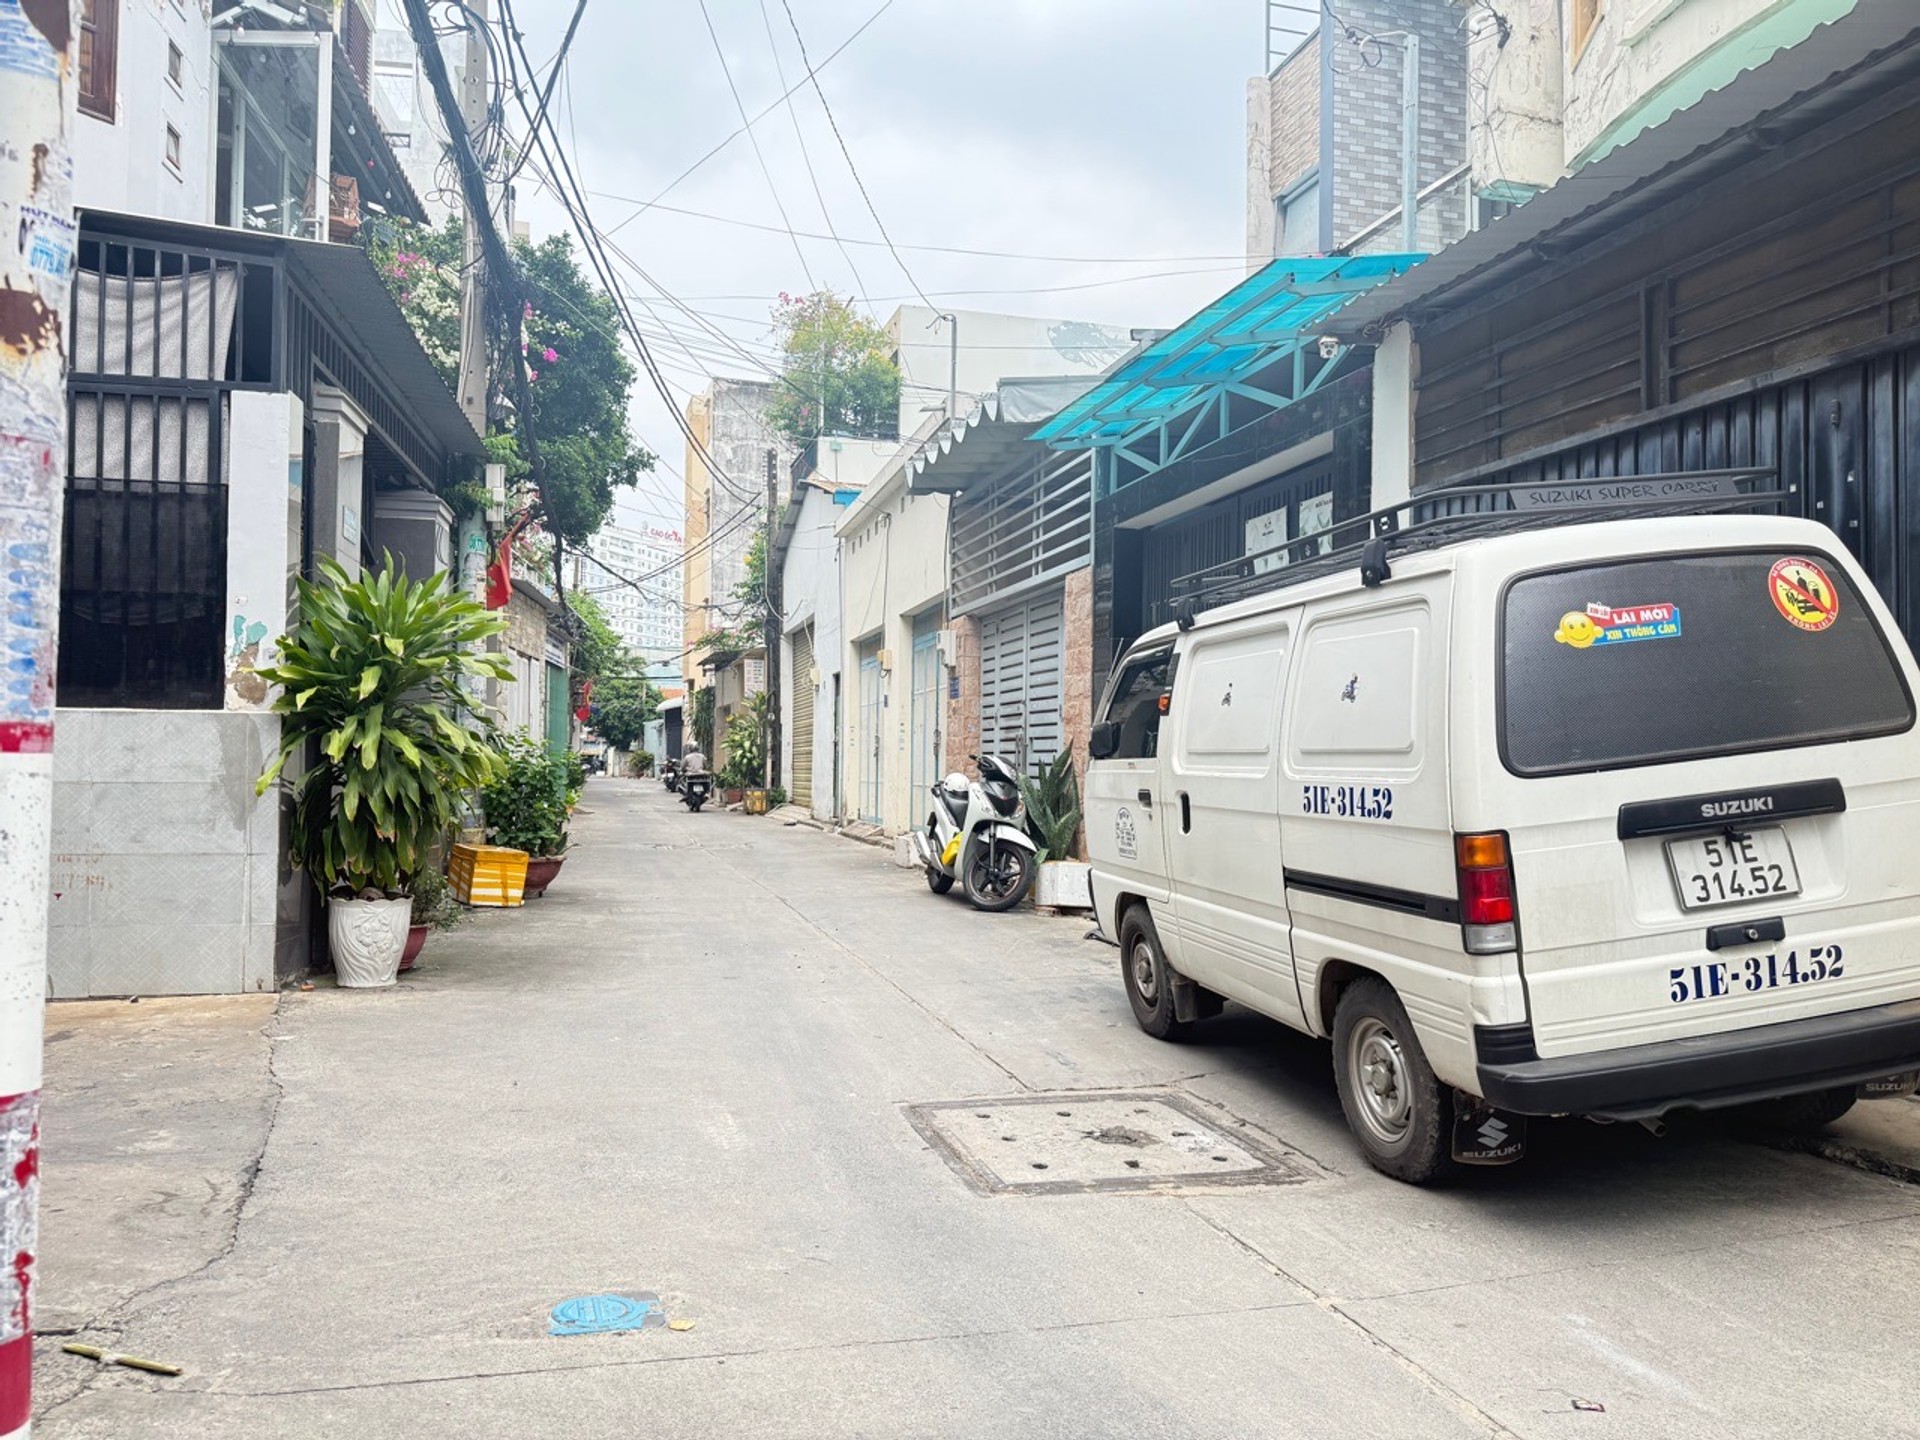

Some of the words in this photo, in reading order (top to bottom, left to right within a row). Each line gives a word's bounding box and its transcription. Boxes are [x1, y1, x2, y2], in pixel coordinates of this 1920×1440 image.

[1530, 488, 1593, 505] SUZUKI
[1598, 484, 1657, 501] SUPER
[1661, 479, 1721, 496] CARRY
[1605, 629, 1623, 641] XIN
[1623, 623, 1656, 638] THÔNG
[1701, 796, 1774, 818] SUZUKI
[1703, 835, 1758, 868] 51E
[1691, 864, 1788, 903] 314.52
[1669, 944, 1845, 1003] 51E-314.52
[1462, 1143, 1521, 1158] SUZUKI
